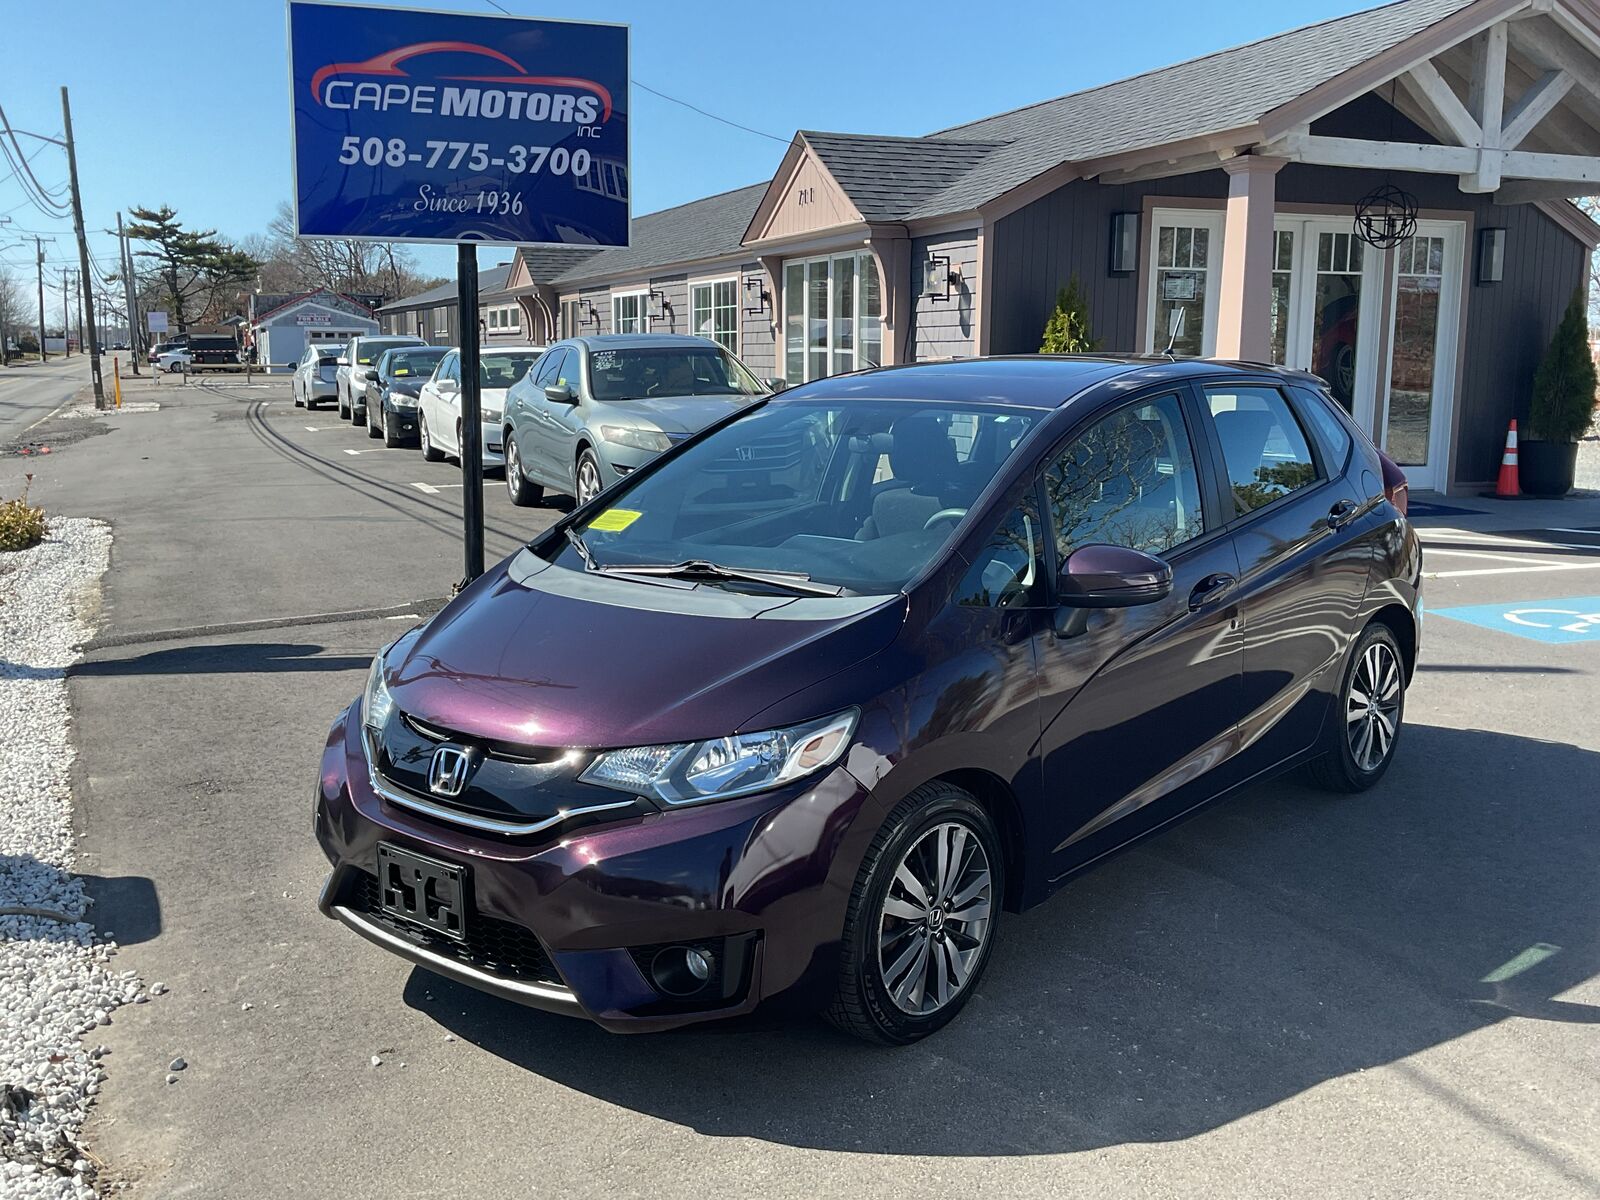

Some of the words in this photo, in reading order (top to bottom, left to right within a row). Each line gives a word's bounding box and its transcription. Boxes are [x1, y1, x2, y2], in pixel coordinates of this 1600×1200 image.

[325, 81, 436, 114] CAPE
[440, 87, 599, 124] MOTORS
[339, 136, 591, 176] 508-775-3700
[413, 184, 469, 213] Since
[476, 191, 523, 215] 1936
